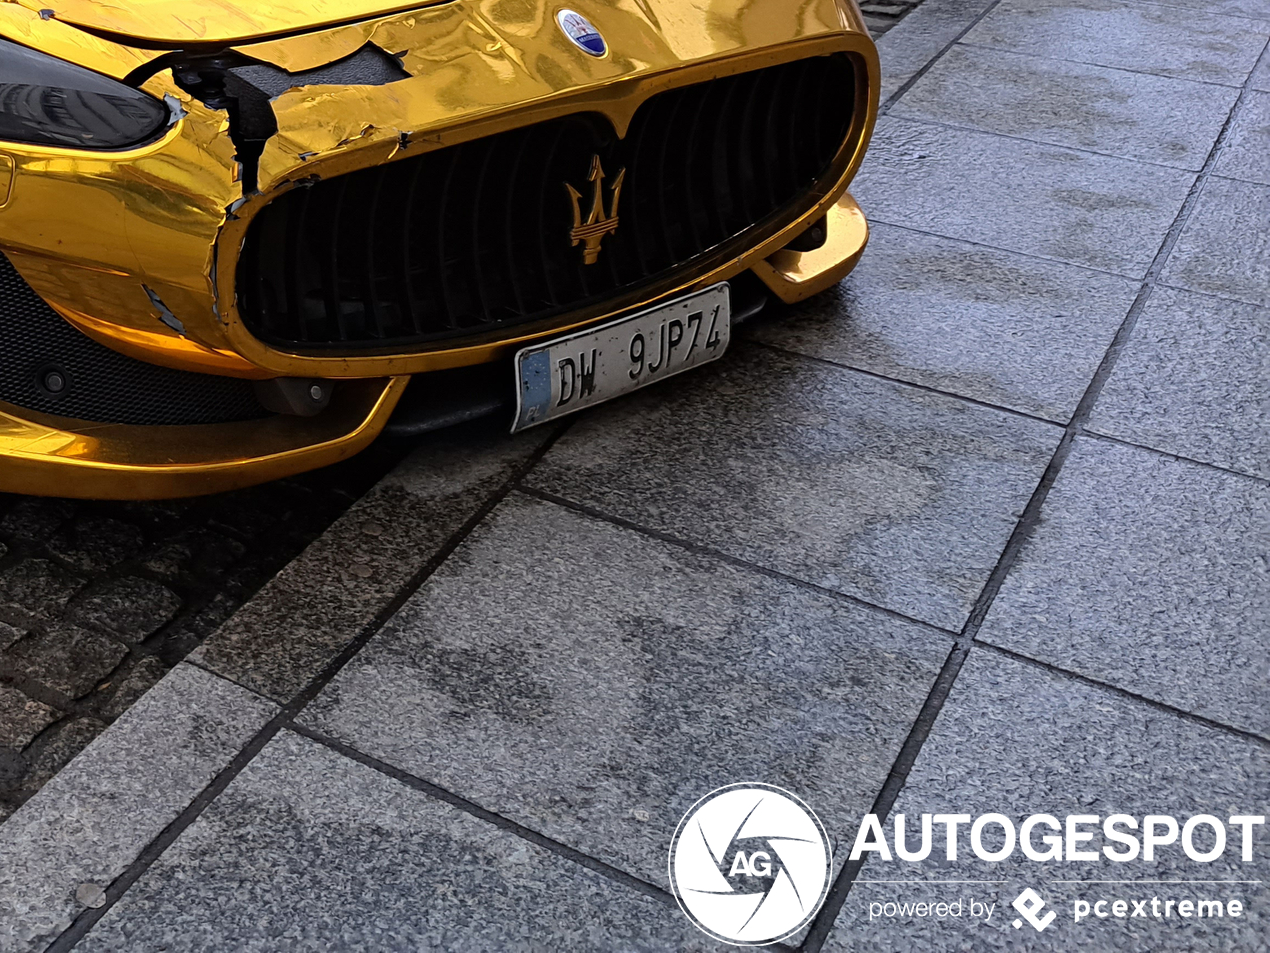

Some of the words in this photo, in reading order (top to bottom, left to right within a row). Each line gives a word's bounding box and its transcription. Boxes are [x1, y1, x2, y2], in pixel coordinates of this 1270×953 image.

[525, 404, 541, 421] PL
[556, 348, 597, 408] DW
[628, 304, 721, 380] 9JP74
